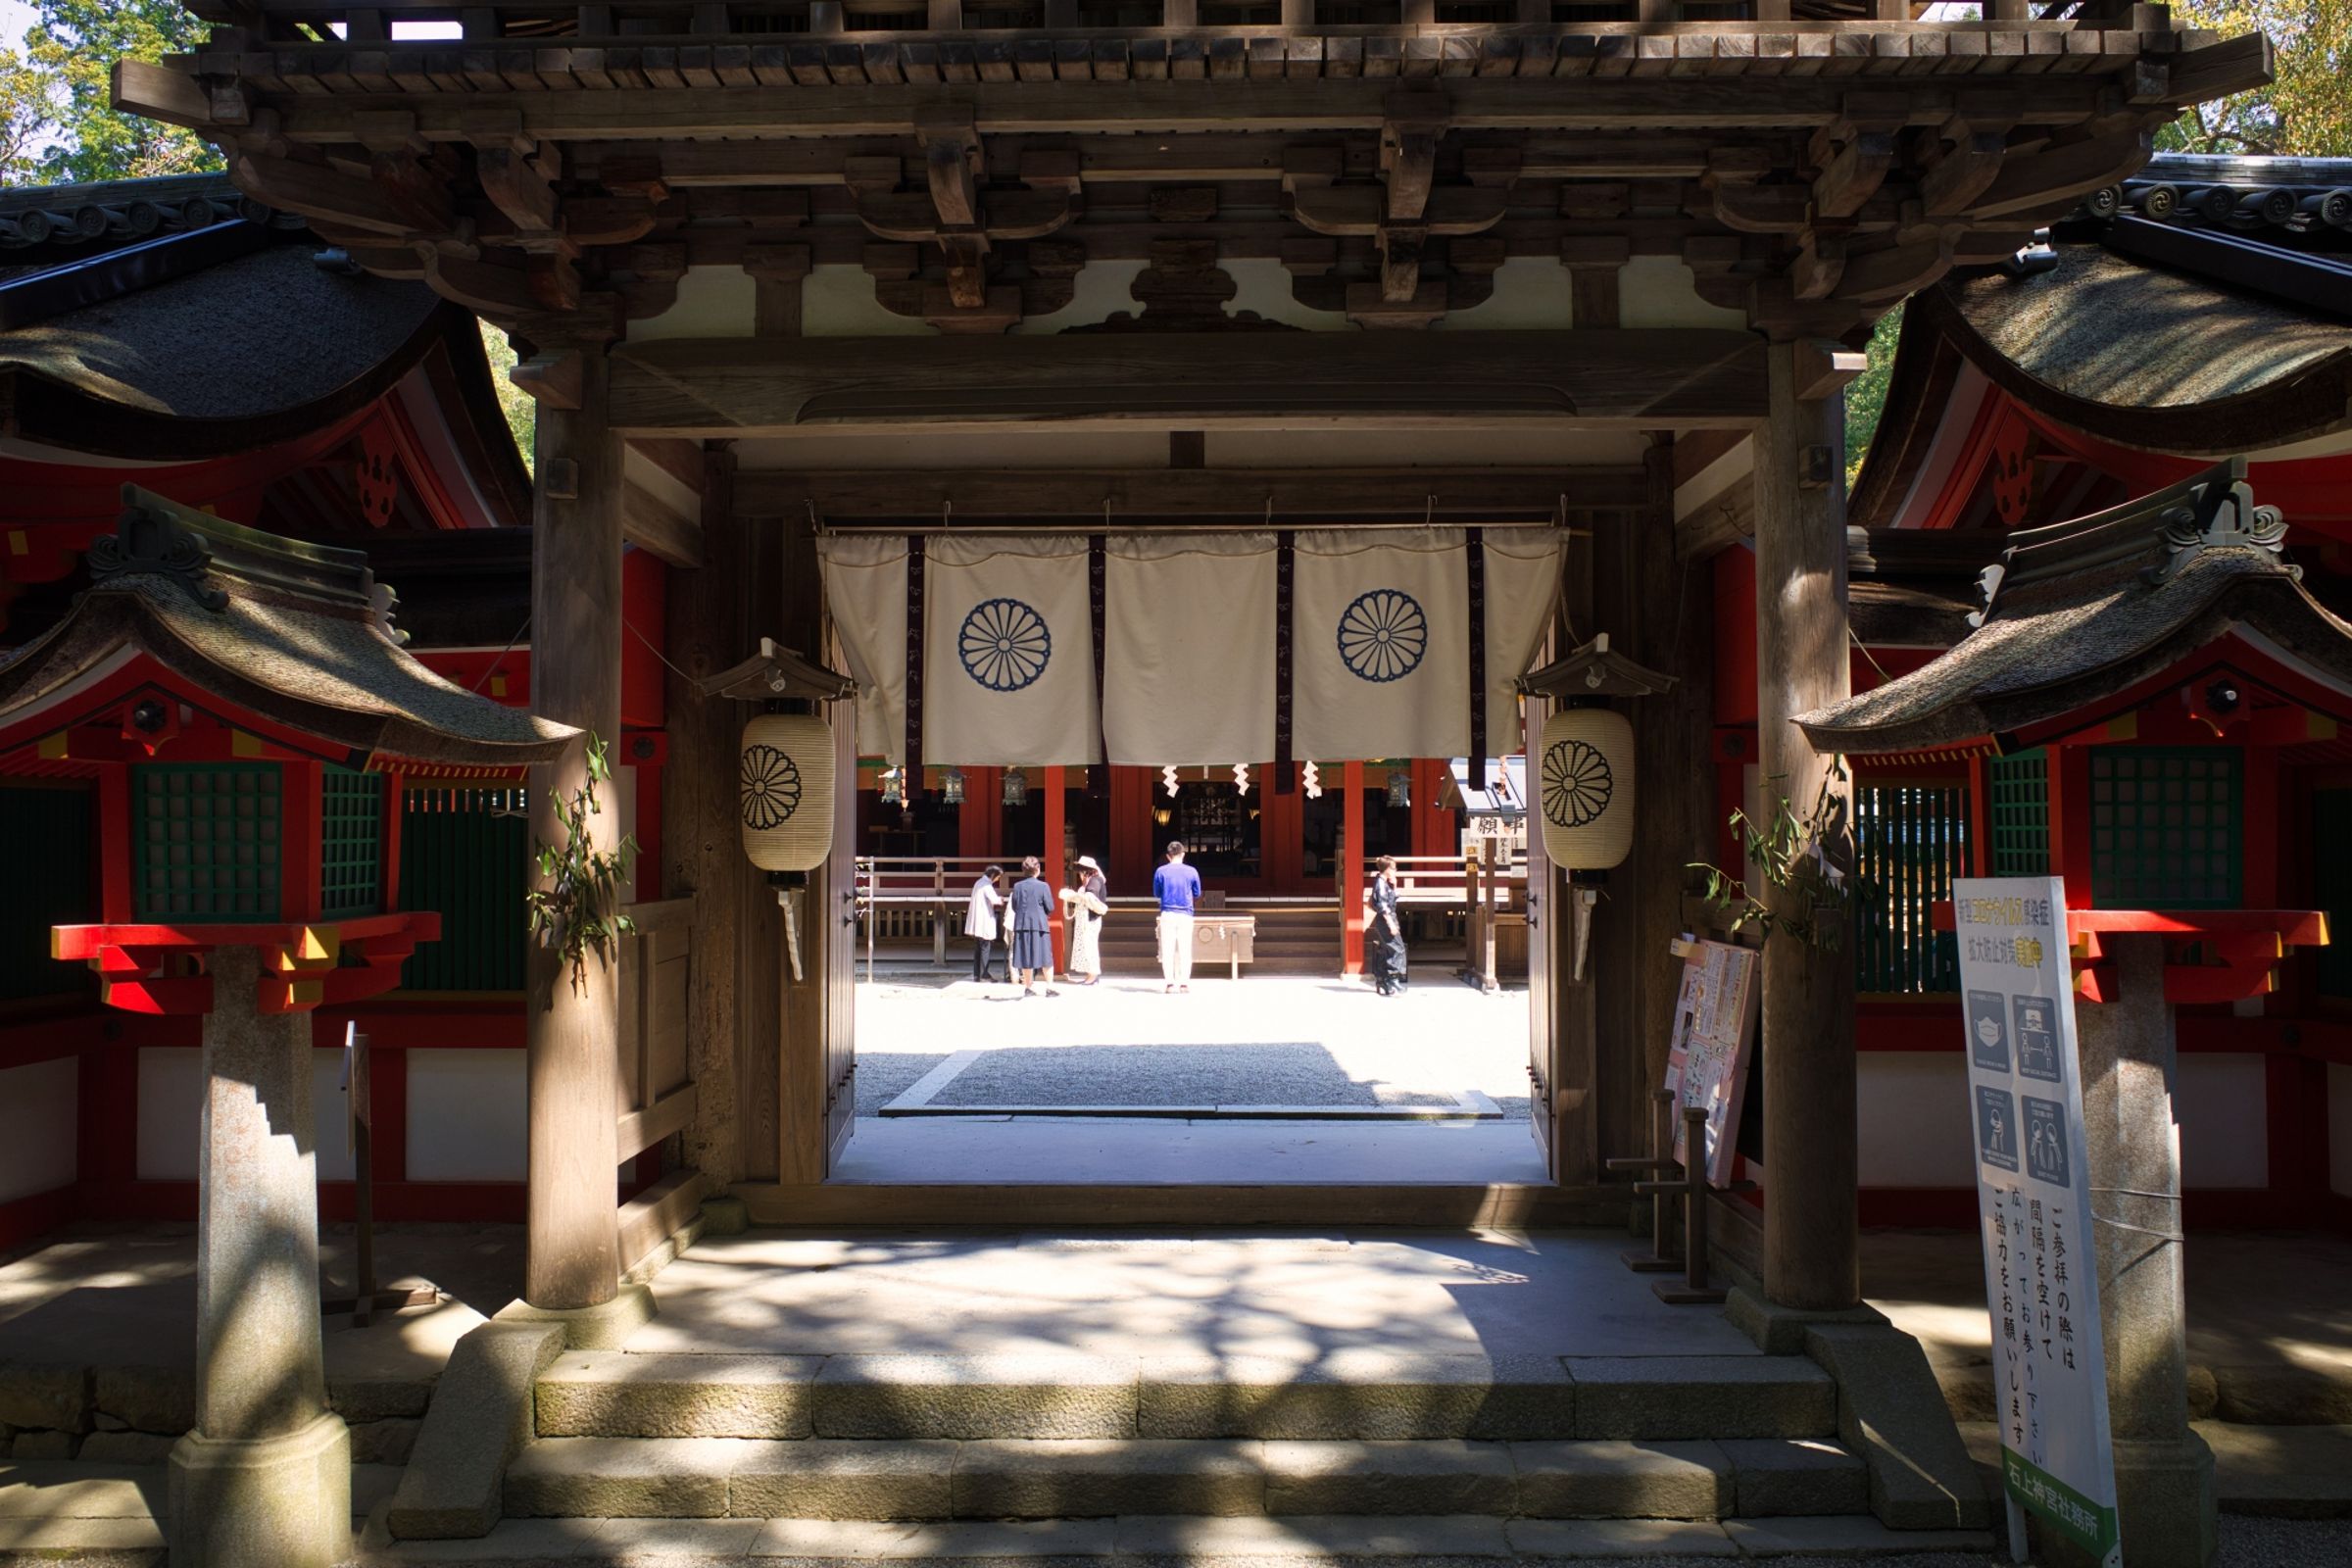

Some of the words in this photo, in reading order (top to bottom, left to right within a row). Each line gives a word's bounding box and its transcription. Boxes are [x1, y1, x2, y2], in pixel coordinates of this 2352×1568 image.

[1958, 896, 2049, 926] 新型コロナウイルス感染症
[1994, 1189, 2024, 1445] ご協力をお願いします
[2012, 1186, 2043, 1464] 広がってお参り下さい
[2030, 1199, 2053, 1360] 間隔を空けて
[2052, 1206, 2076, 1371] ご参拝の際は
[2009, 1461, 2098, 1541] 石上神宮社務所
